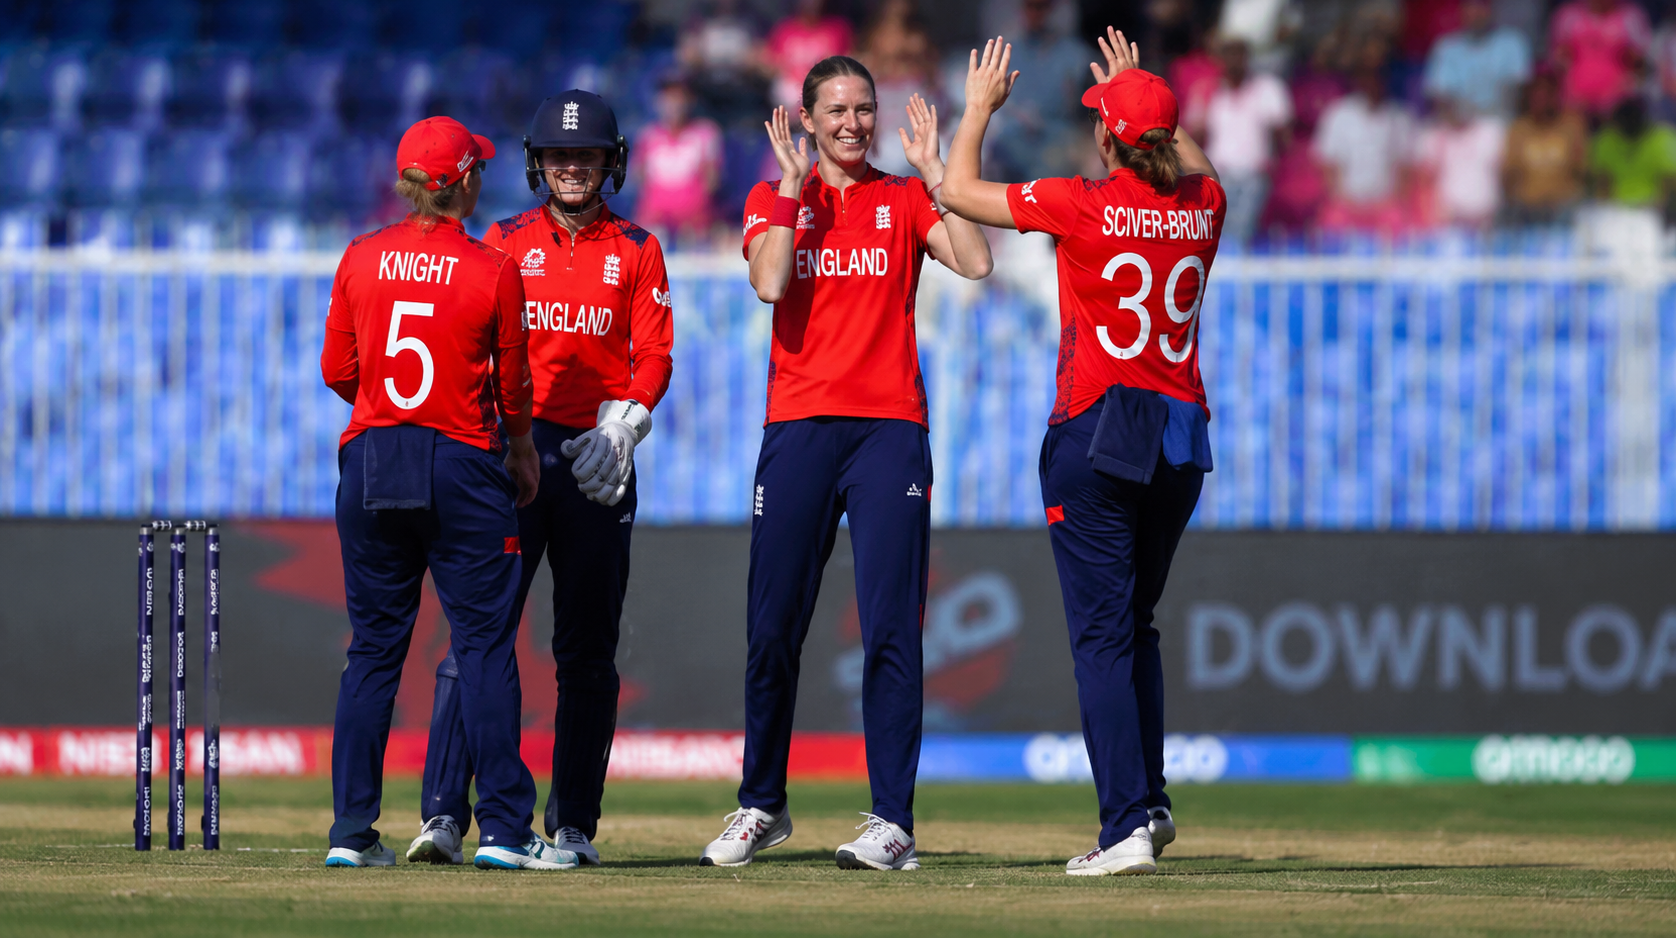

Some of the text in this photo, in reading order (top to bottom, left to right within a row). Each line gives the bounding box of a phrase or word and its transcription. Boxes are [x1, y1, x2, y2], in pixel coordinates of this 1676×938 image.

[1101, 205, 1215, 241] SCIVER-BRUNT
[378, 250, 459, 286] KNIGHT
[796, 247, 889, 279] ENGLAND
[525, 301, 613, 337] ENGLAND
[1095, 251, 1207, 364] 39
[384, 301, 435, 410] 5
